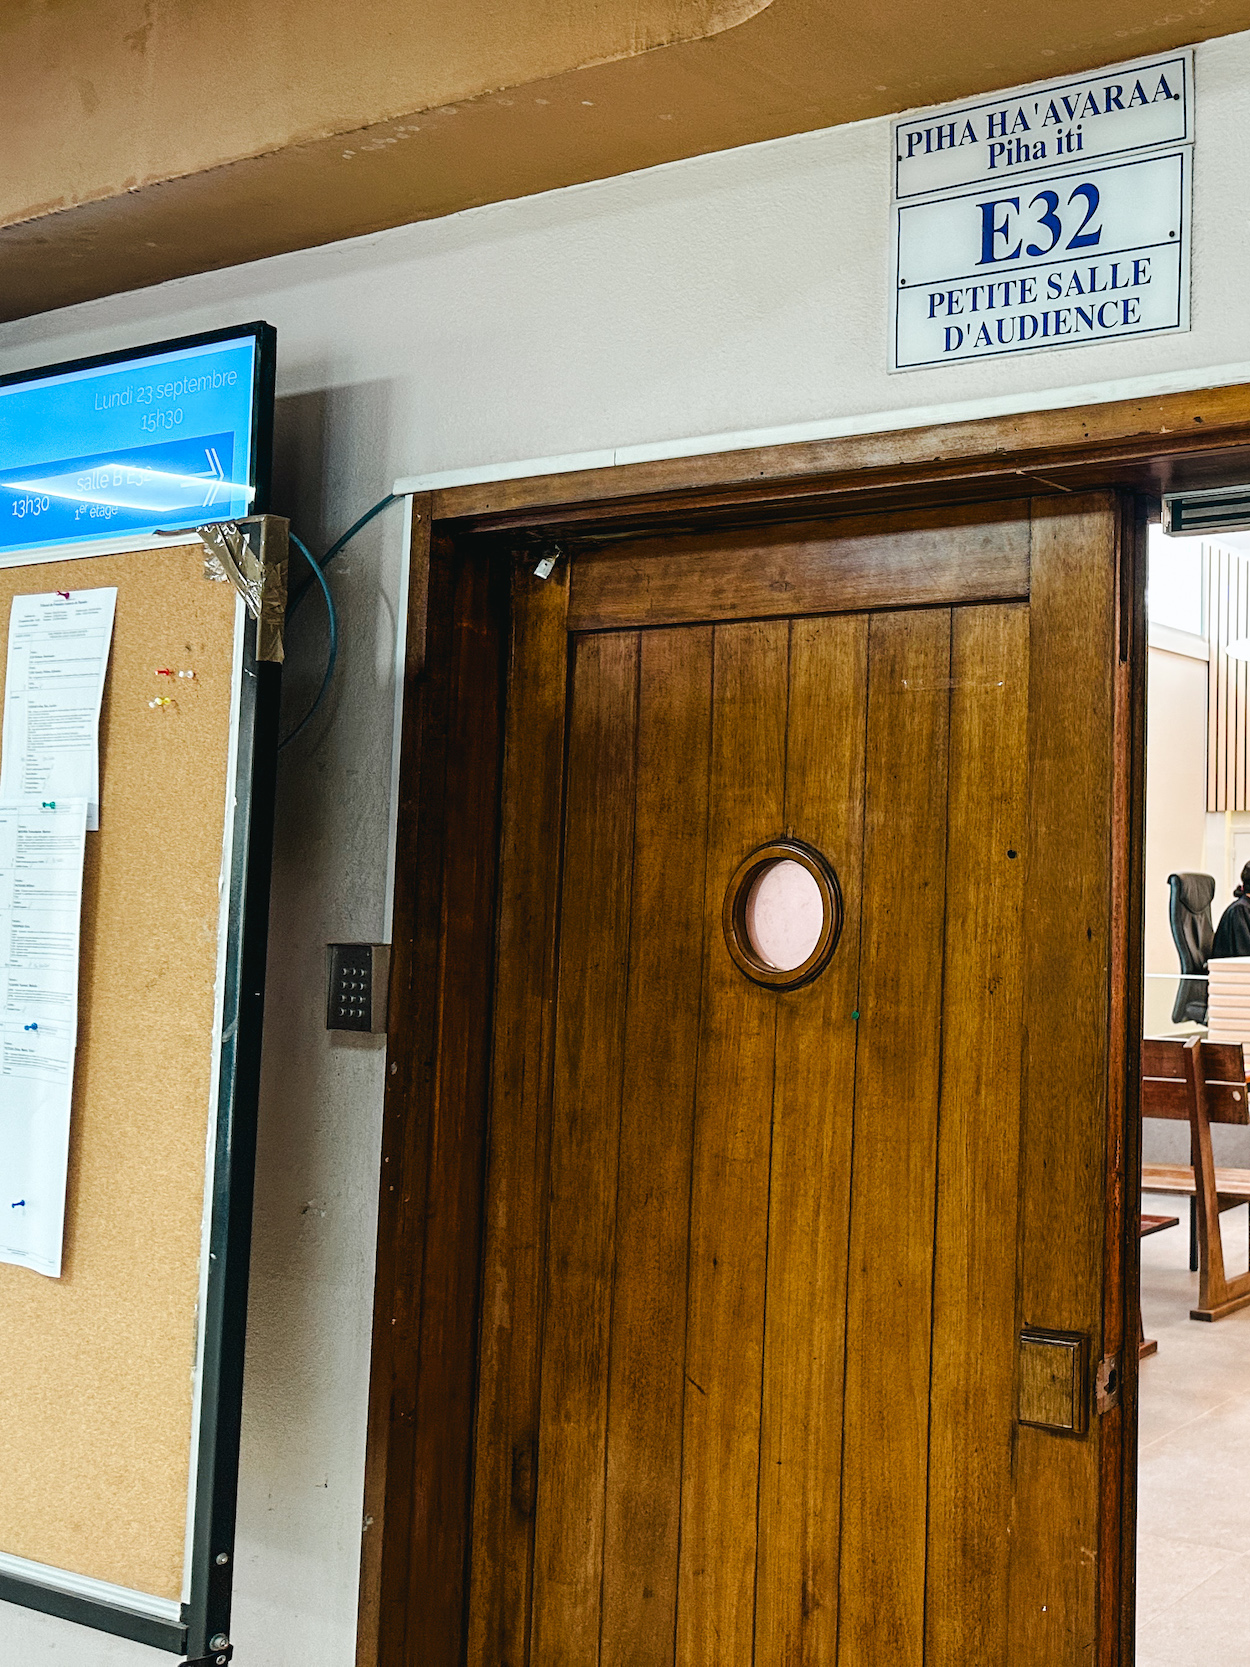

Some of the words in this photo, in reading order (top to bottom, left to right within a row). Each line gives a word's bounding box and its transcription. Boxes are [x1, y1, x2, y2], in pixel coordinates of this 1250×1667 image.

[905, 119, 978, 158] PIHA
[987, 139, 1047, 170] Piha
[1056, 124, 1085, 155] iti
[975, 182, 1103, 266] E32
[927, 277, 1039, 319] PETITE
[1046, 257, 1152, 300] SALLE
[943, 297, 1142, 353] D'AUDIENCE
[94, 386, 133, 411] Lundi
[136, 386, 153, 405] 23
[156, 369, 238, 401] septembre
[140, 408, 184, 433] 15h30
[76, 471, 110, 492] salle
[11, 495, 50, 518] 13h30
